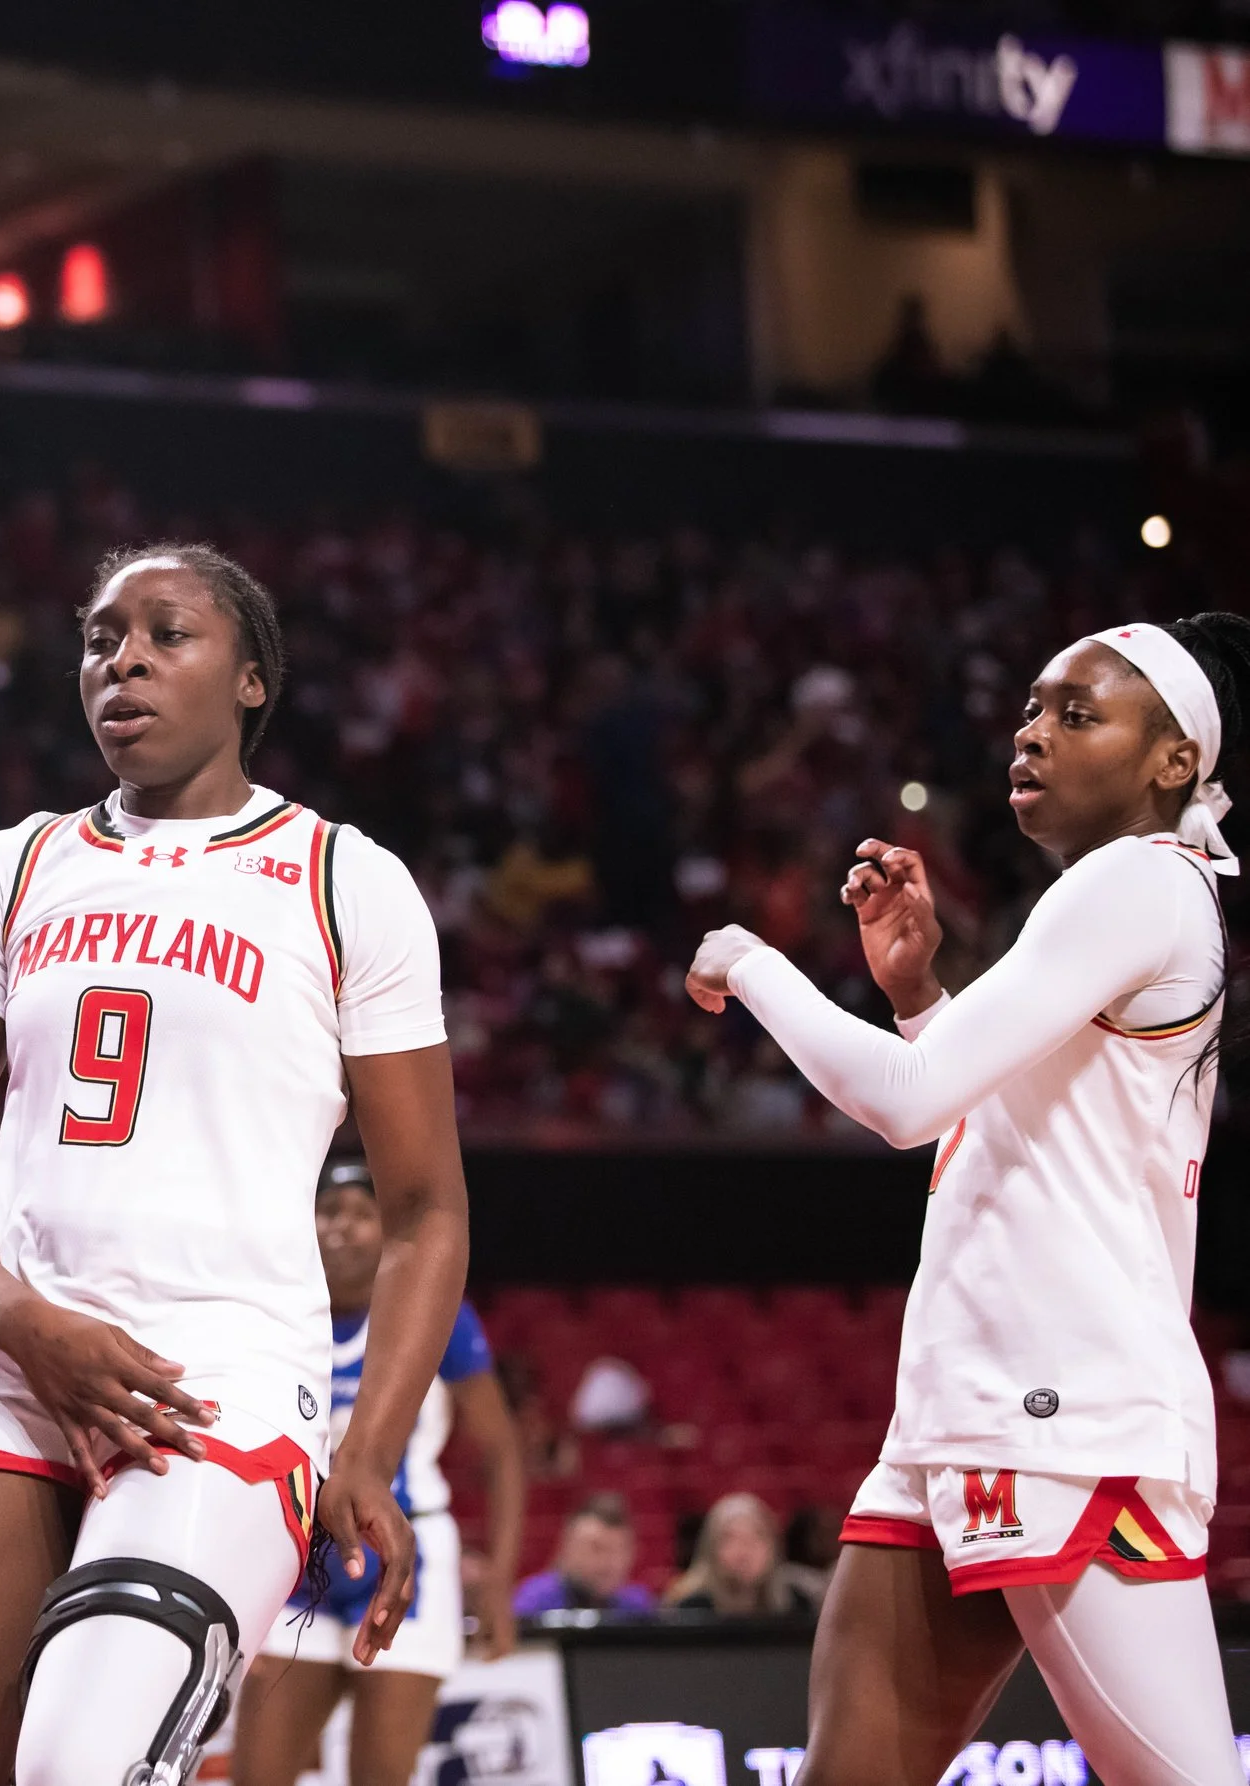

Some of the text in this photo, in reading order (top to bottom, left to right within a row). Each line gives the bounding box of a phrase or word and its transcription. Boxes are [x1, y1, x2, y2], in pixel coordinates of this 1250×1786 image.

[12, 912, 265, 1004] MARYLAND
[58, 985, 153, 1147] 9
[963, 1467, 1022, 1533] M
